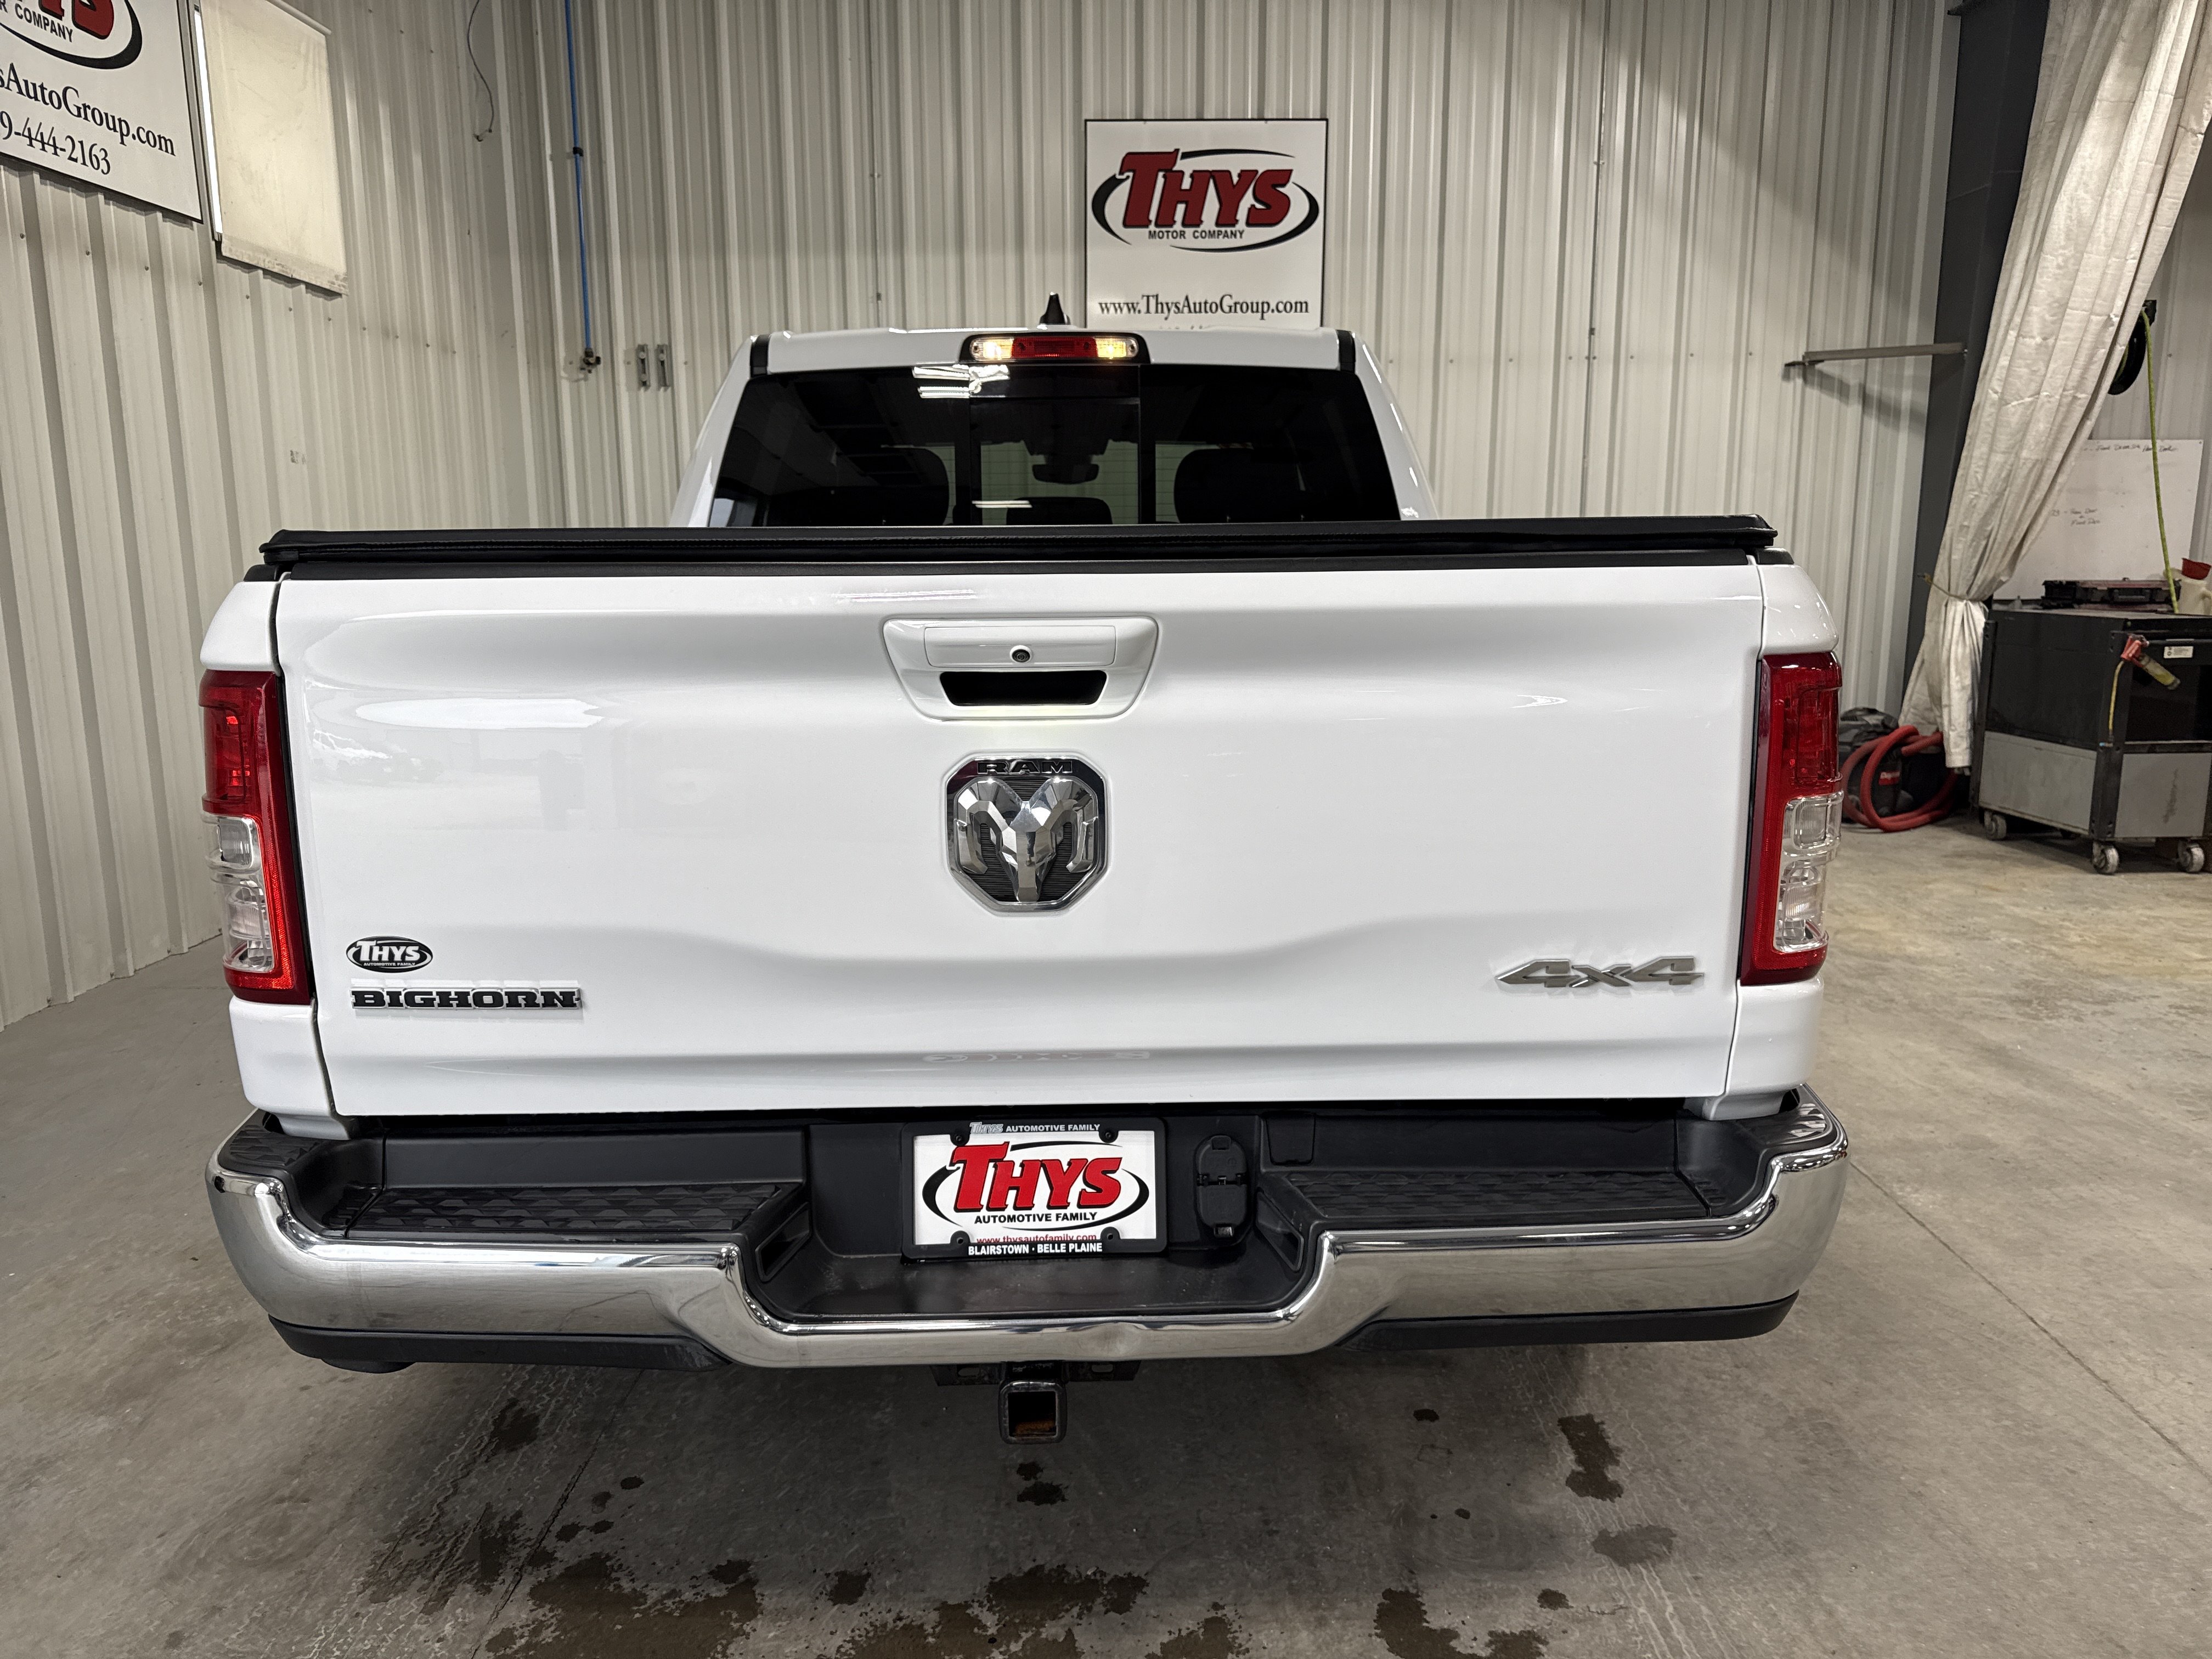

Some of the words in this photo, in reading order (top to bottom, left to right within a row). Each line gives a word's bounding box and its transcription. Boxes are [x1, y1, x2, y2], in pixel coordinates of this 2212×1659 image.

[14, 3, 73, 43] COMPANY
[1119, 148, 1294, 228] THYS
[1148, 229, 1186, 240] MOTOR
[1192, 229, 1245, 240] COMPANY
[1098, 294, 1310, 320] www.ThysAutoGroup.com
[977, 760, 1073, 775] RAM
[357, 940, 421, 962] THYS
[350, 989, 580, 1009] BIGHORN
[969, 1121, 1004, 1134] THYS
[950, 1141, 1122, 1212] THYS
[974, 1214, 1052, 1224] AUTOMOTIVE
[1056, 1212, 1098, 1222] FAMILY
[977, 1234, 1097, 1243] wwwthysautofamilycom
[968, 1244, 1029, 1256] BLAIRSTOWN
[1037, 1243, 1066, 1253] BELLE
[1069, 1242, 1103, 1252] PLAINE
